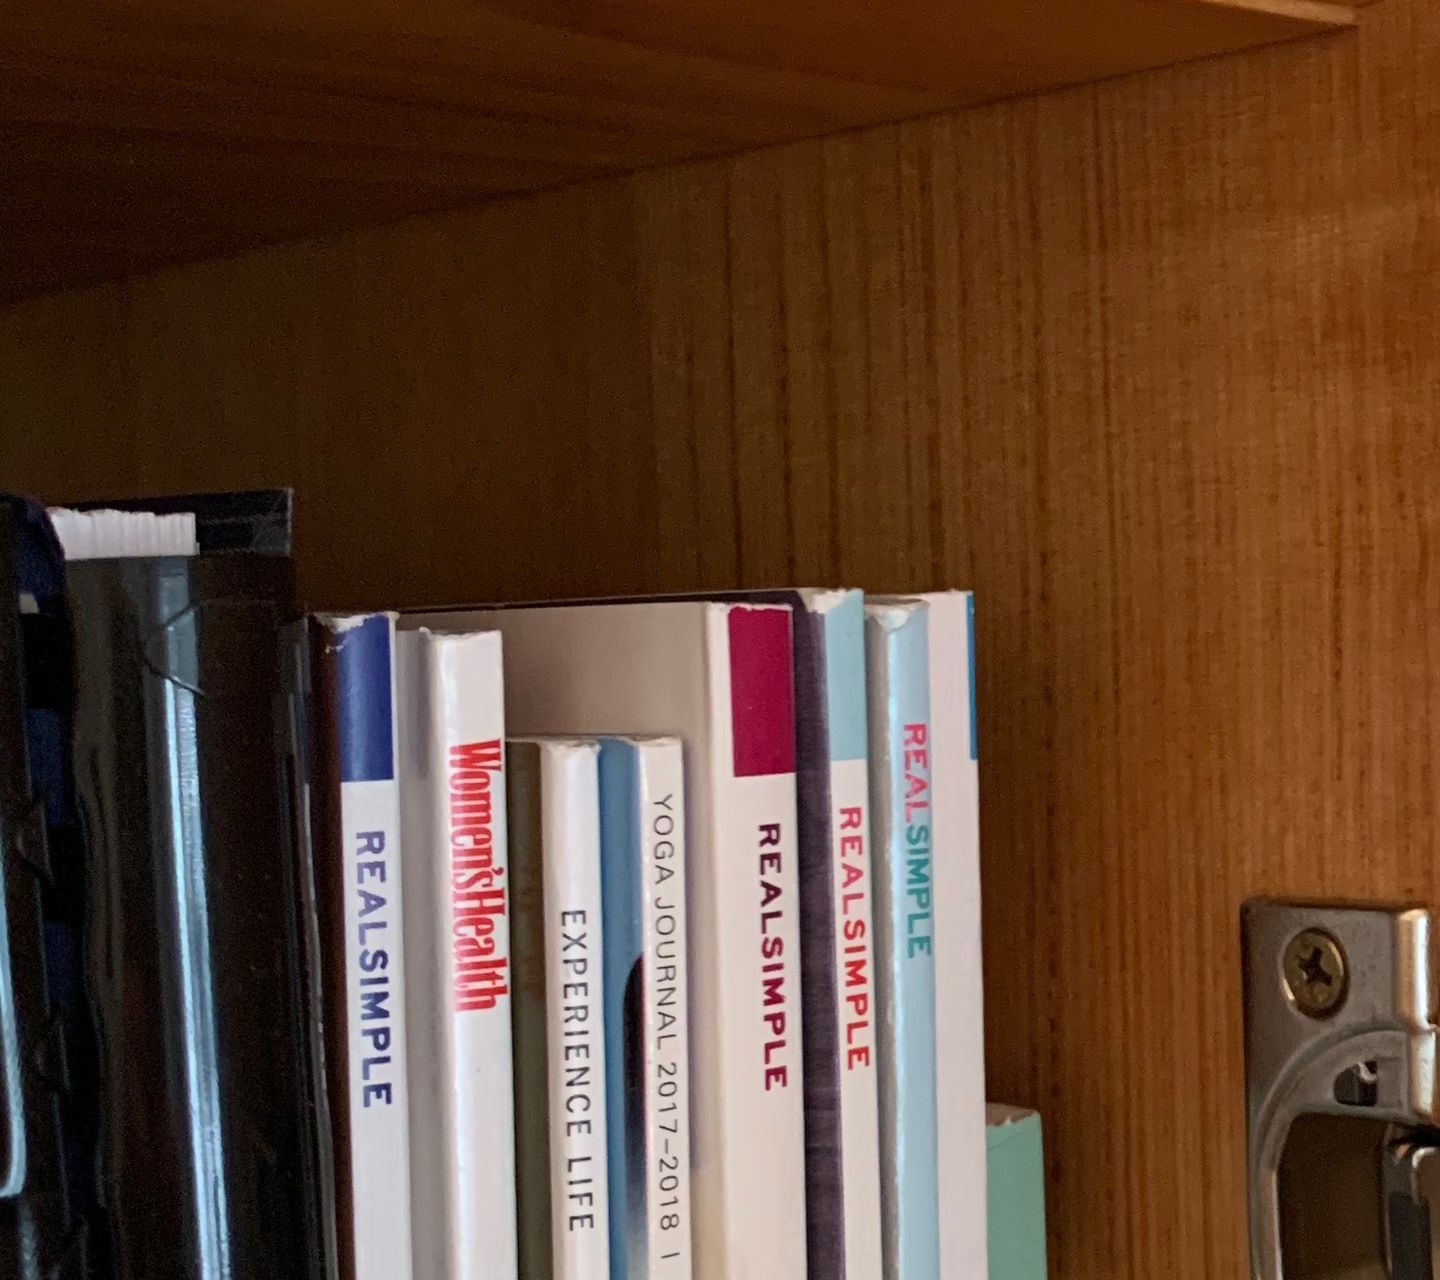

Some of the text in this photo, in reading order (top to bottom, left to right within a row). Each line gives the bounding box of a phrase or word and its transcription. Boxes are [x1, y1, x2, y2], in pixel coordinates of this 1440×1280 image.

[652, 793, 675, 885] YOGA
[654, 896, 677, 1051] JOURNAL
[560, 909, 595, 1232] EXPERIENCE LIFE
